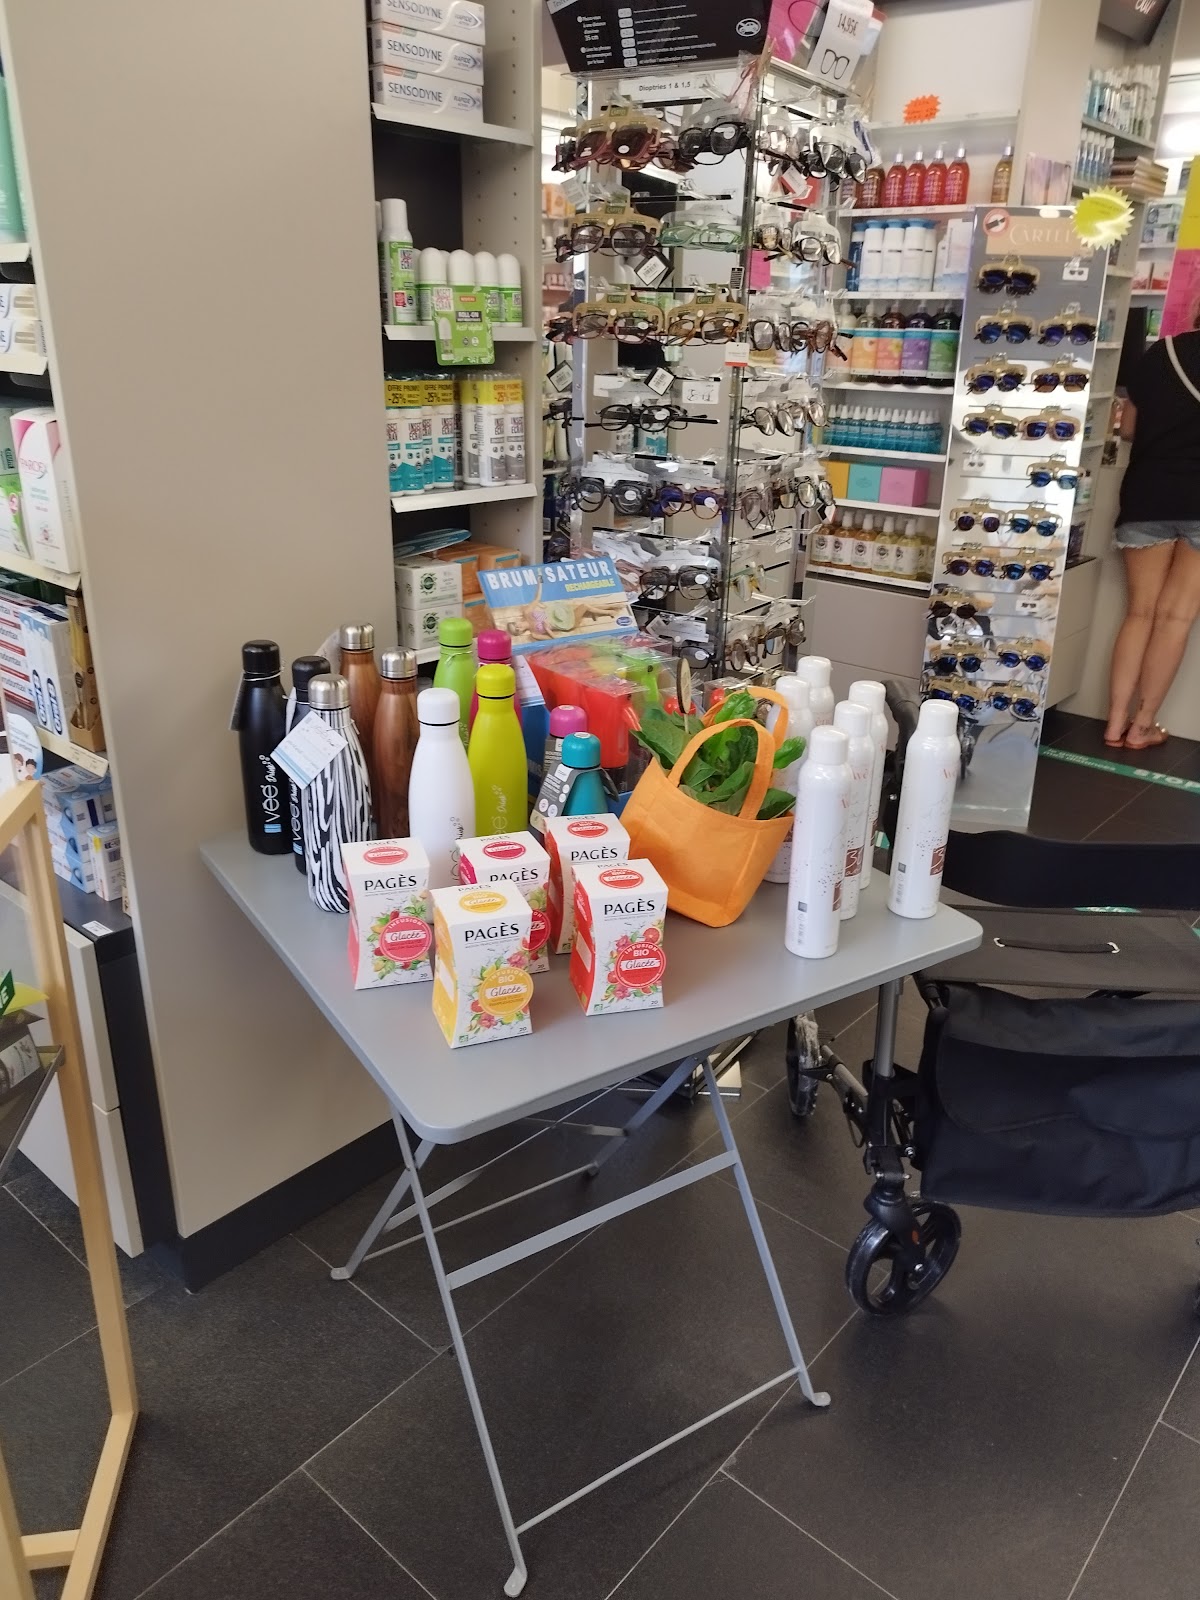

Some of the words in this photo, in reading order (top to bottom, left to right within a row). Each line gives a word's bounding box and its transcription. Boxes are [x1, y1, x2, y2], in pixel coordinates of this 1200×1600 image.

[387, 0, 443, 19] SENSODYNE
[837, 13, 858, 36] 14,95€
[387, 39, 442, 61] SENSODYNE
[388, 82, 442, 102] SENSODYNE
[638, 84, 667, 92] Dioptries
[387, 384, 402, 392] OFFRE
[571, 846, 618, 861] PAGÈS
[489, 867, 539, 883] PAGÈS
[364, 874, 417, 891] PAGÈS
[604, 898, 656, 916] PAGÈS
[388, 917, 423, 930] INFUSION
[390, 932, 422, 942] Glacée
[464, 922, 519, 943] PAGÈS
[625, 942, 659, 956] INFUSION
[632, 948, 651, 957] BIO
[624, 959, 656, 970] Glacée
[488, 969, 525, 982] INFUSION
[497, 975, 515, 985] BIO
[490, 986, 524, 999] Glacée
